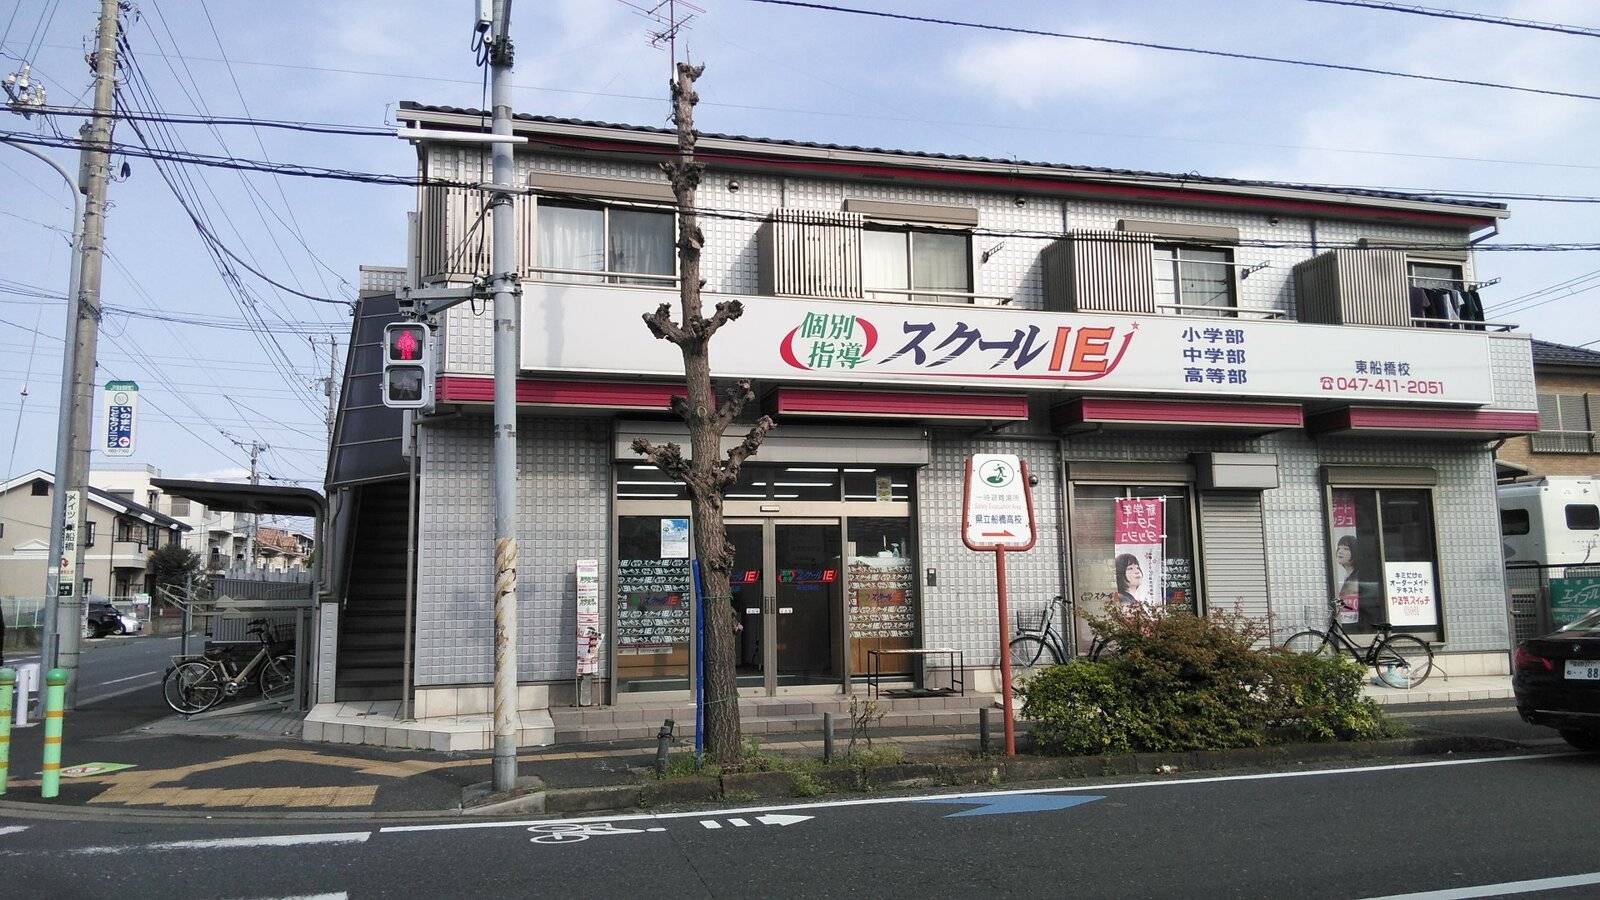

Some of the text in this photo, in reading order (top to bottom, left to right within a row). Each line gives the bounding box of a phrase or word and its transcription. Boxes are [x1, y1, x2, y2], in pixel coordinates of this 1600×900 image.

[800, 312, 858, 340] 個別
[1182, 326, 1245, 345] 小学部
[807, 341, 863, 370] 指導
[877, 321, 1115, 373] スクールIE
[1183, 347, 1246, 364] 中学部
[1184, 367, 1248, 384] 高等部
[1355, 360, 1411, 376] 東船橋校
[975, 514, 1022, 525] 県立船橋高校
